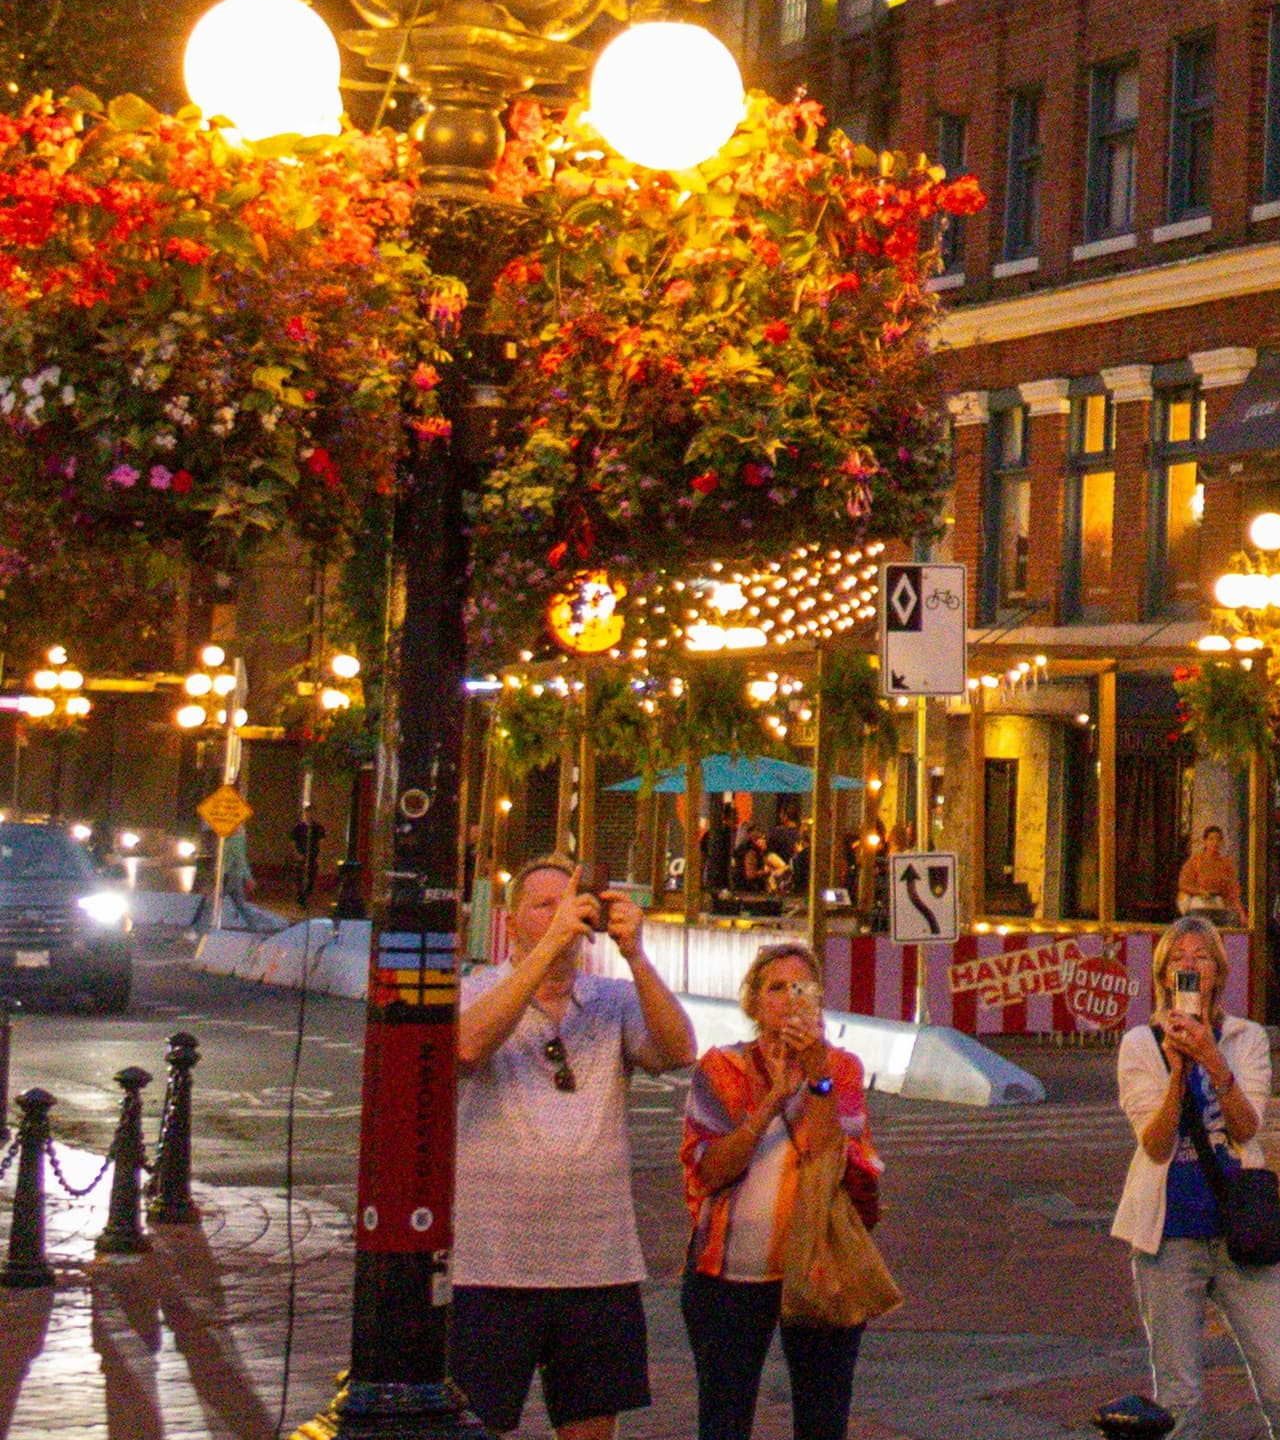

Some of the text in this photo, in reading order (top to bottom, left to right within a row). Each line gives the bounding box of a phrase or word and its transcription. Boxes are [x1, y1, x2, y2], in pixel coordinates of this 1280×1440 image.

[949, 939, 1082, 991] HAVANA
[1060, 958, 1141, 997] Havana
[979, 968, 1065, 1009] CLUB
[1074, 988, 1120, 1017] Club
